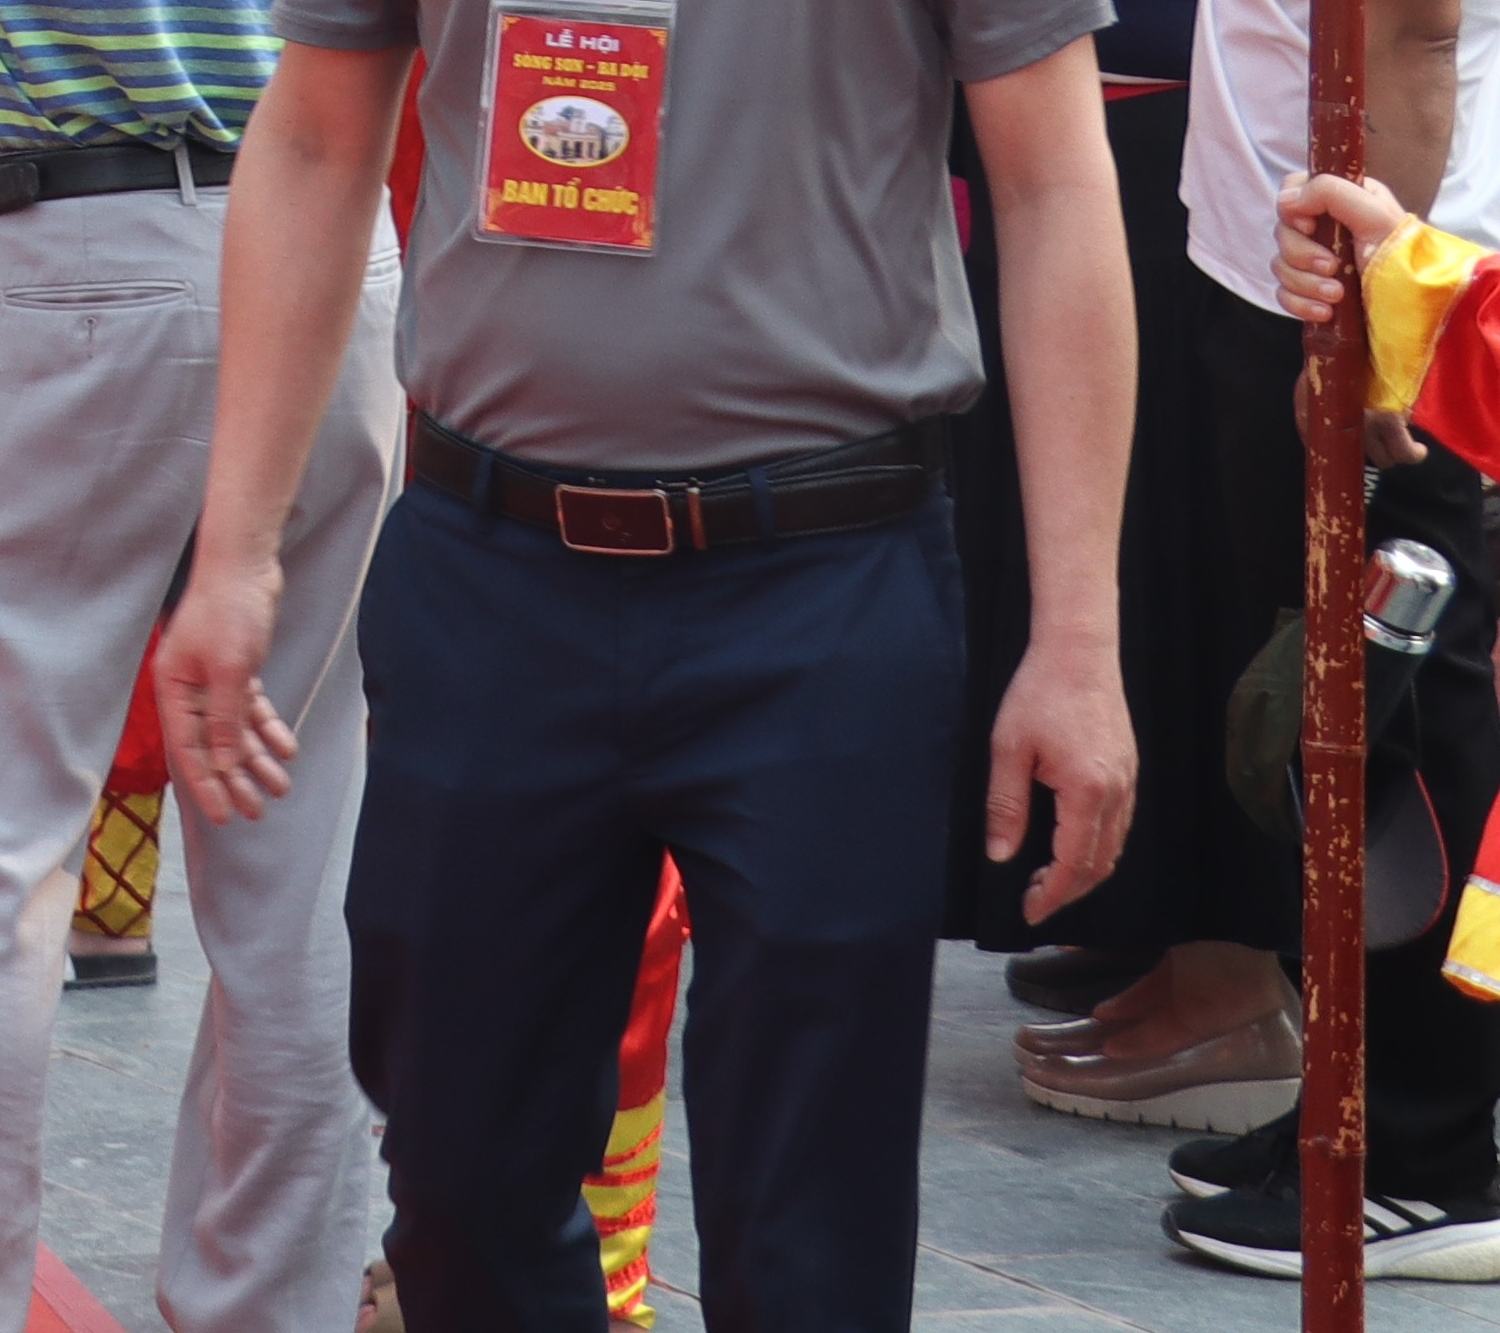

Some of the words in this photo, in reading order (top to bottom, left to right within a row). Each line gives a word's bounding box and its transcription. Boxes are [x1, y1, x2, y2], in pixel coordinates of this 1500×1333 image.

[545, 29, 574, 48] LỄ
[579, 35, 620, 54] HỘI
[502, 179, 549, 207] BAN
[552, 177, 581, 209] TỔ
[583, 185, 640, 215] CHỨC
